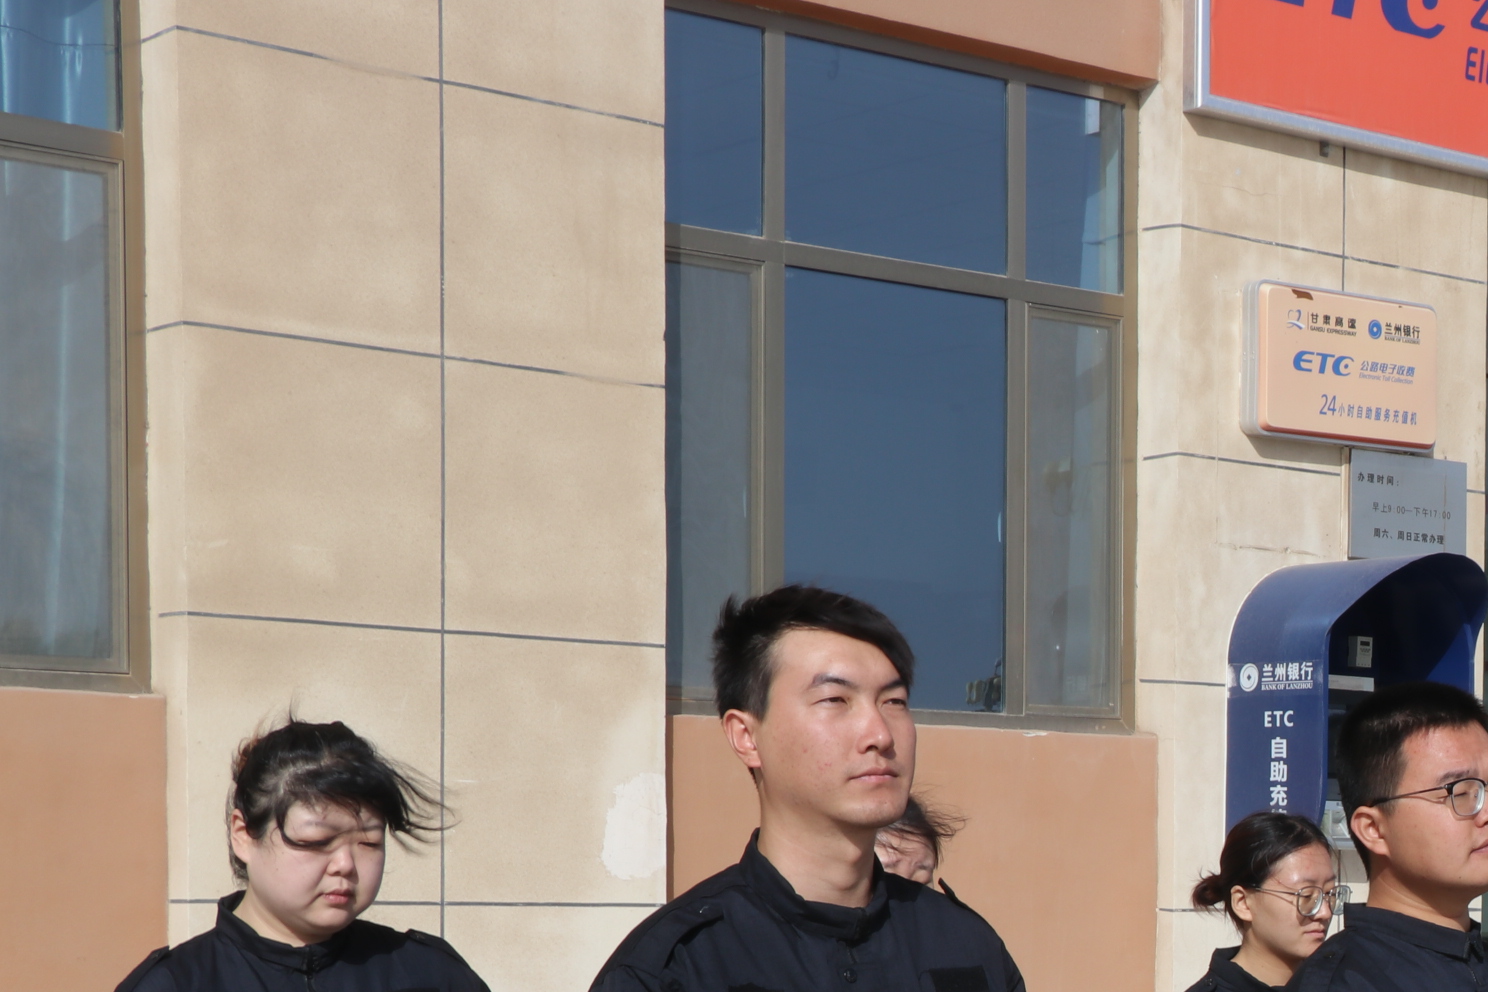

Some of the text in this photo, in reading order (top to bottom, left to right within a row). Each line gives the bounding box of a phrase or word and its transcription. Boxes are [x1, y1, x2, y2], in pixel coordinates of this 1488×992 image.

[1384, 322, 1421, 339] 兰州银行
[1292, 350, 1355, 377] ETC
[1360, 360, 1416, 377] 公路电子收费
[1319, 394, 1418, 426] 24小时自助服务充值机
[1373, 527, 1445, 545] 周六、周日正常办理
[1261, 661, 1313, 681] 兰州银行
[1261, 683, 1277, 691] BANK
[1286, 682, 1313, 690] LANZHOU
[1264, 710, 1294, 727] ETC
[1269, 737, 1288, 813] 自助充
